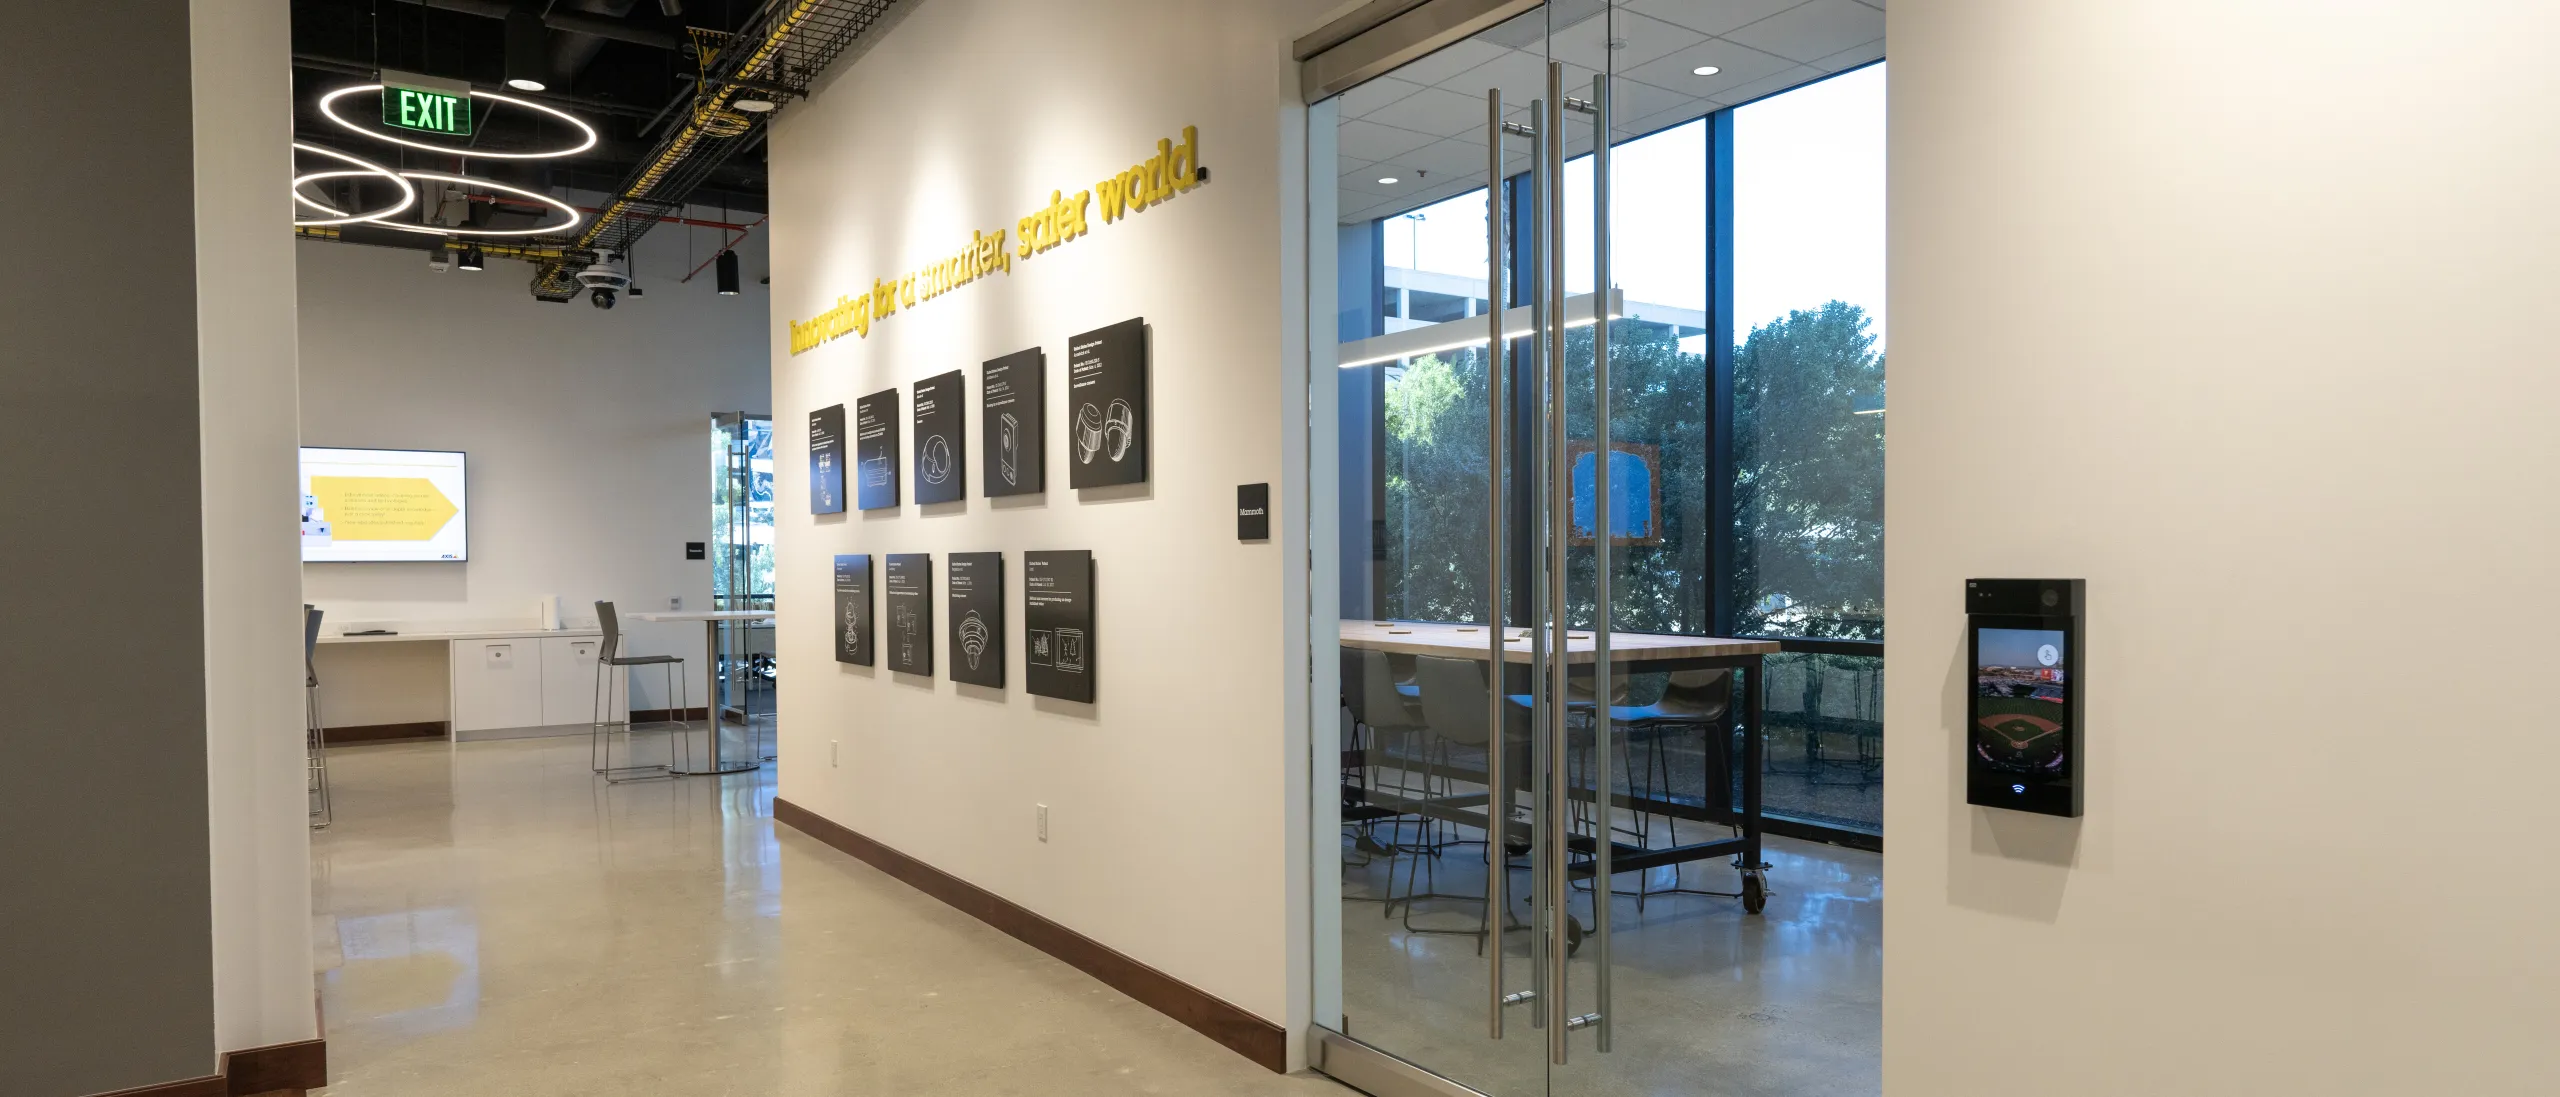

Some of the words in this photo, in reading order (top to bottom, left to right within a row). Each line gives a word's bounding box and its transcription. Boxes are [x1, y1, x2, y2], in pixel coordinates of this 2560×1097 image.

[400, 90, 457, 132] EXIT
[789, 292, 870, 355] Innovating
[873, 277, 897, 319] for
[901, 271, 916, 307] a
[920, 229, 1010, 300] smarter,
[1017, 189, 1090, 257] safer
[1096, 125, 1207, 221] world.
